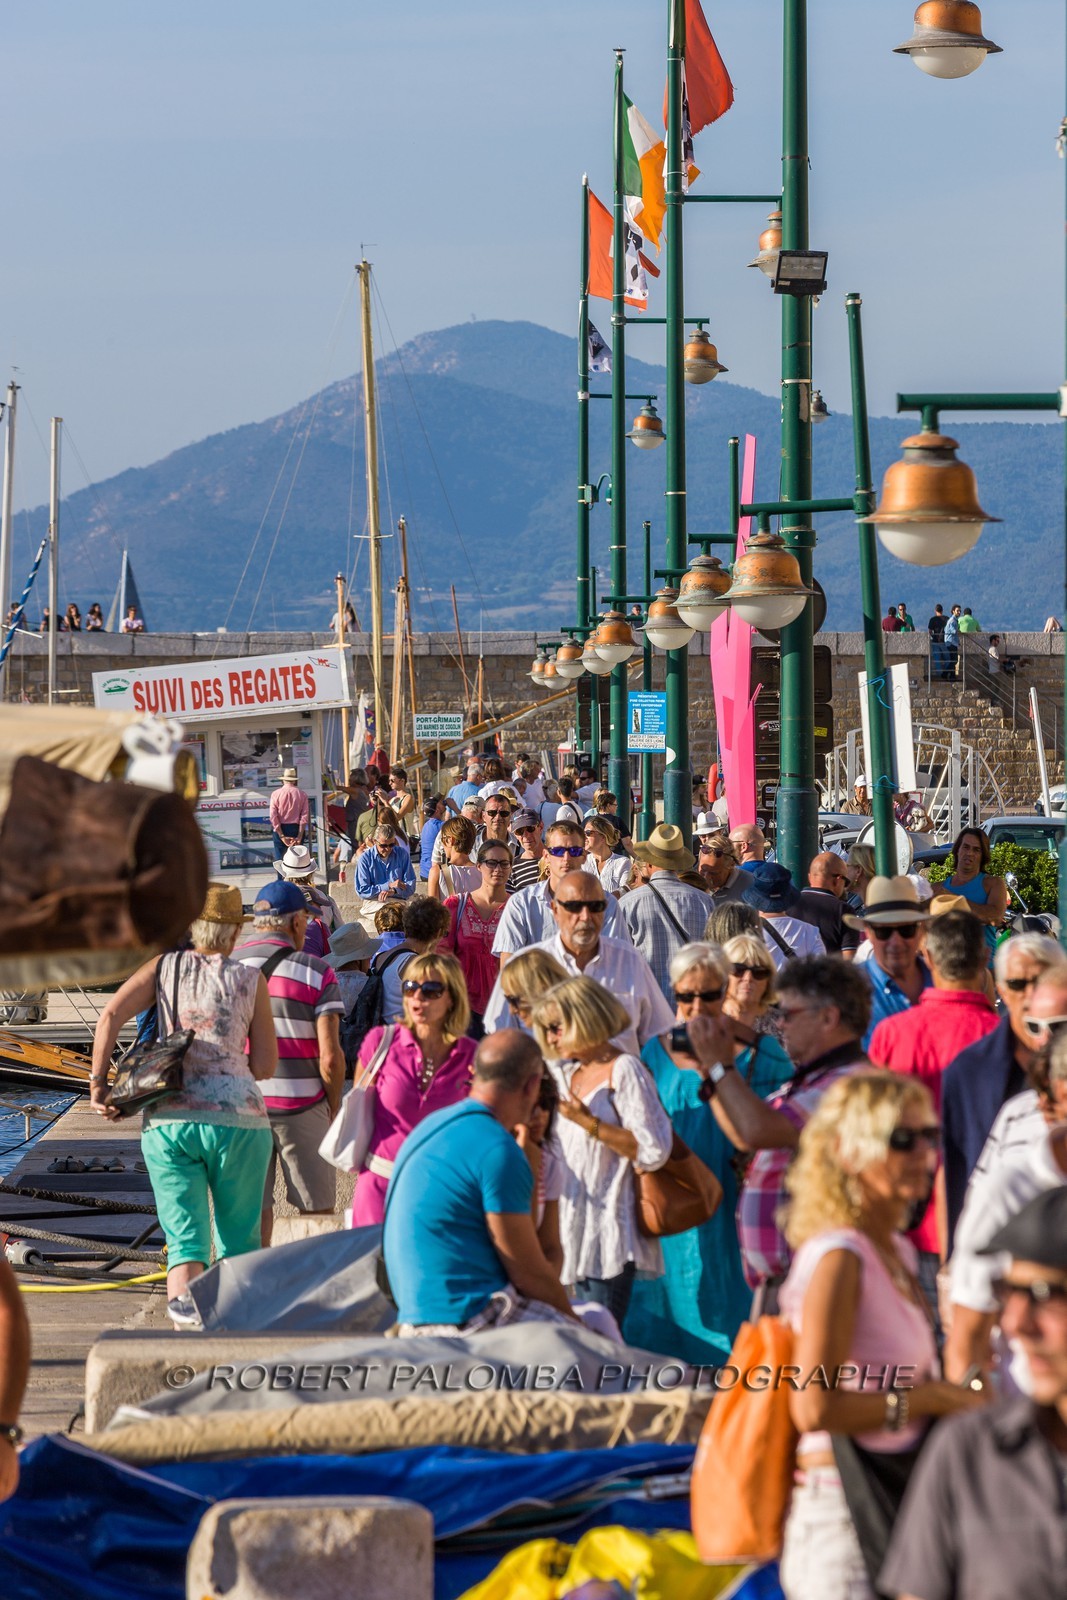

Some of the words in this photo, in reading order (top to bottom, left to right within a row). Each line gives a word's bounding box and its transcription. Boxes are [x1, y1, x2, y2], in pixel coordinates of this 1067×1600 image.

[132, 677, 186, 713] SUIVI
[190, 677, 224, 710] DES
[228, 663, 317, 706] REGATES
[200, 801, 268, 811] EXCURSIONS
